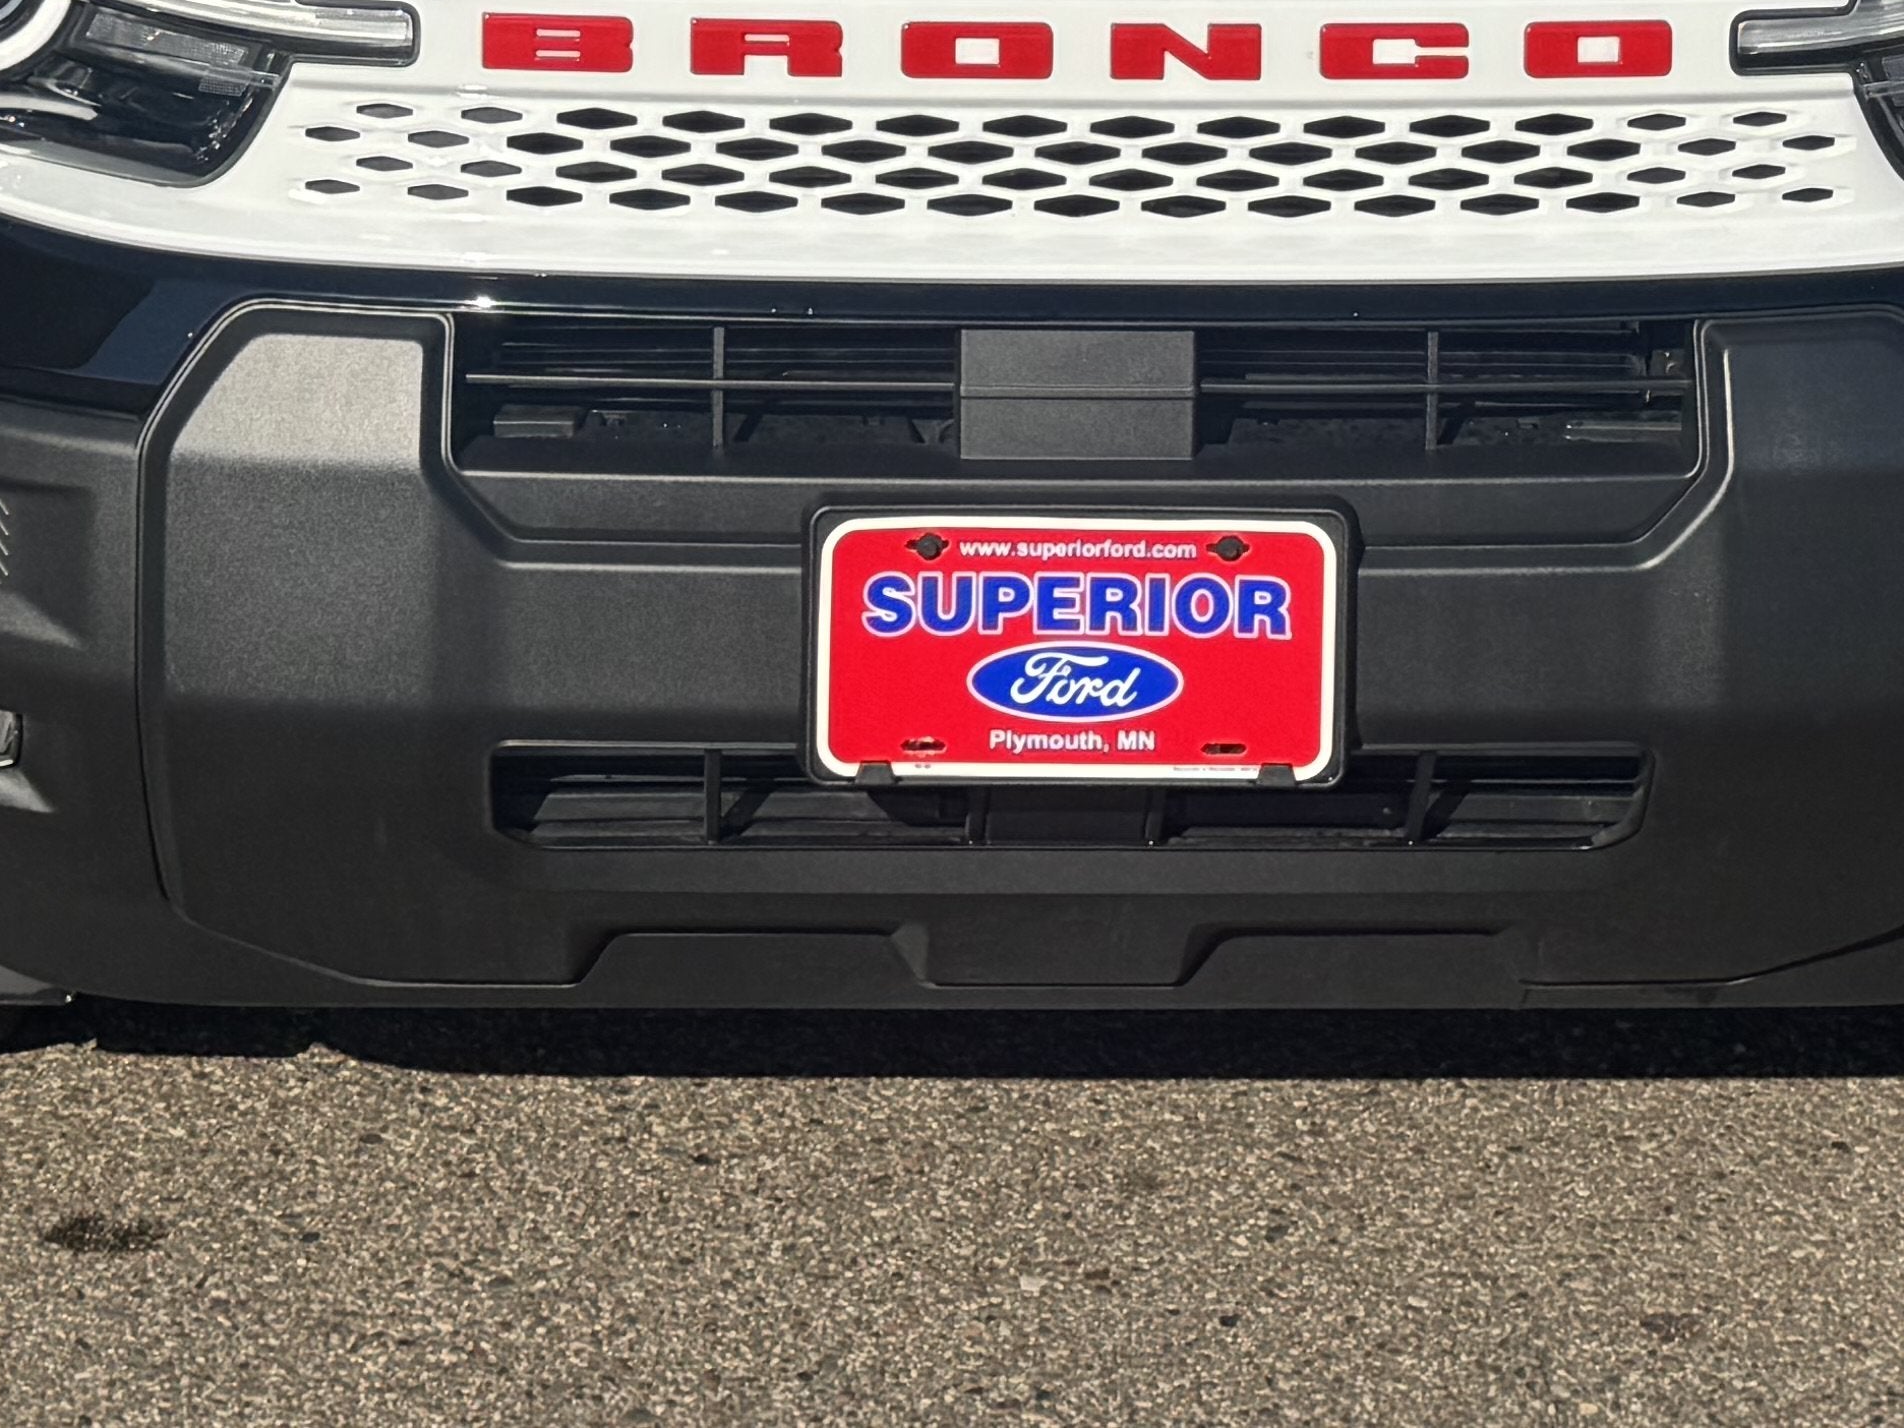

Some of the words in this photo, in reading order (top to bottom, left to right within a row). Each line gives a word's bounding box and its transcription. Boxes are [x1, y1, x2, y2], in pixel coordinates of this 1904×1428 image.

[481, 12, 1673, 82] BRONCO
[959, 538, 1197, 561] www.superiorford.com
[862, 572, 1291, 639] SUPERIOR
[1010, 652, 1142, 707] Ford
[989, 729, 1110, 754] Plymouth,
[1117, 730, 1156, 751] MN
